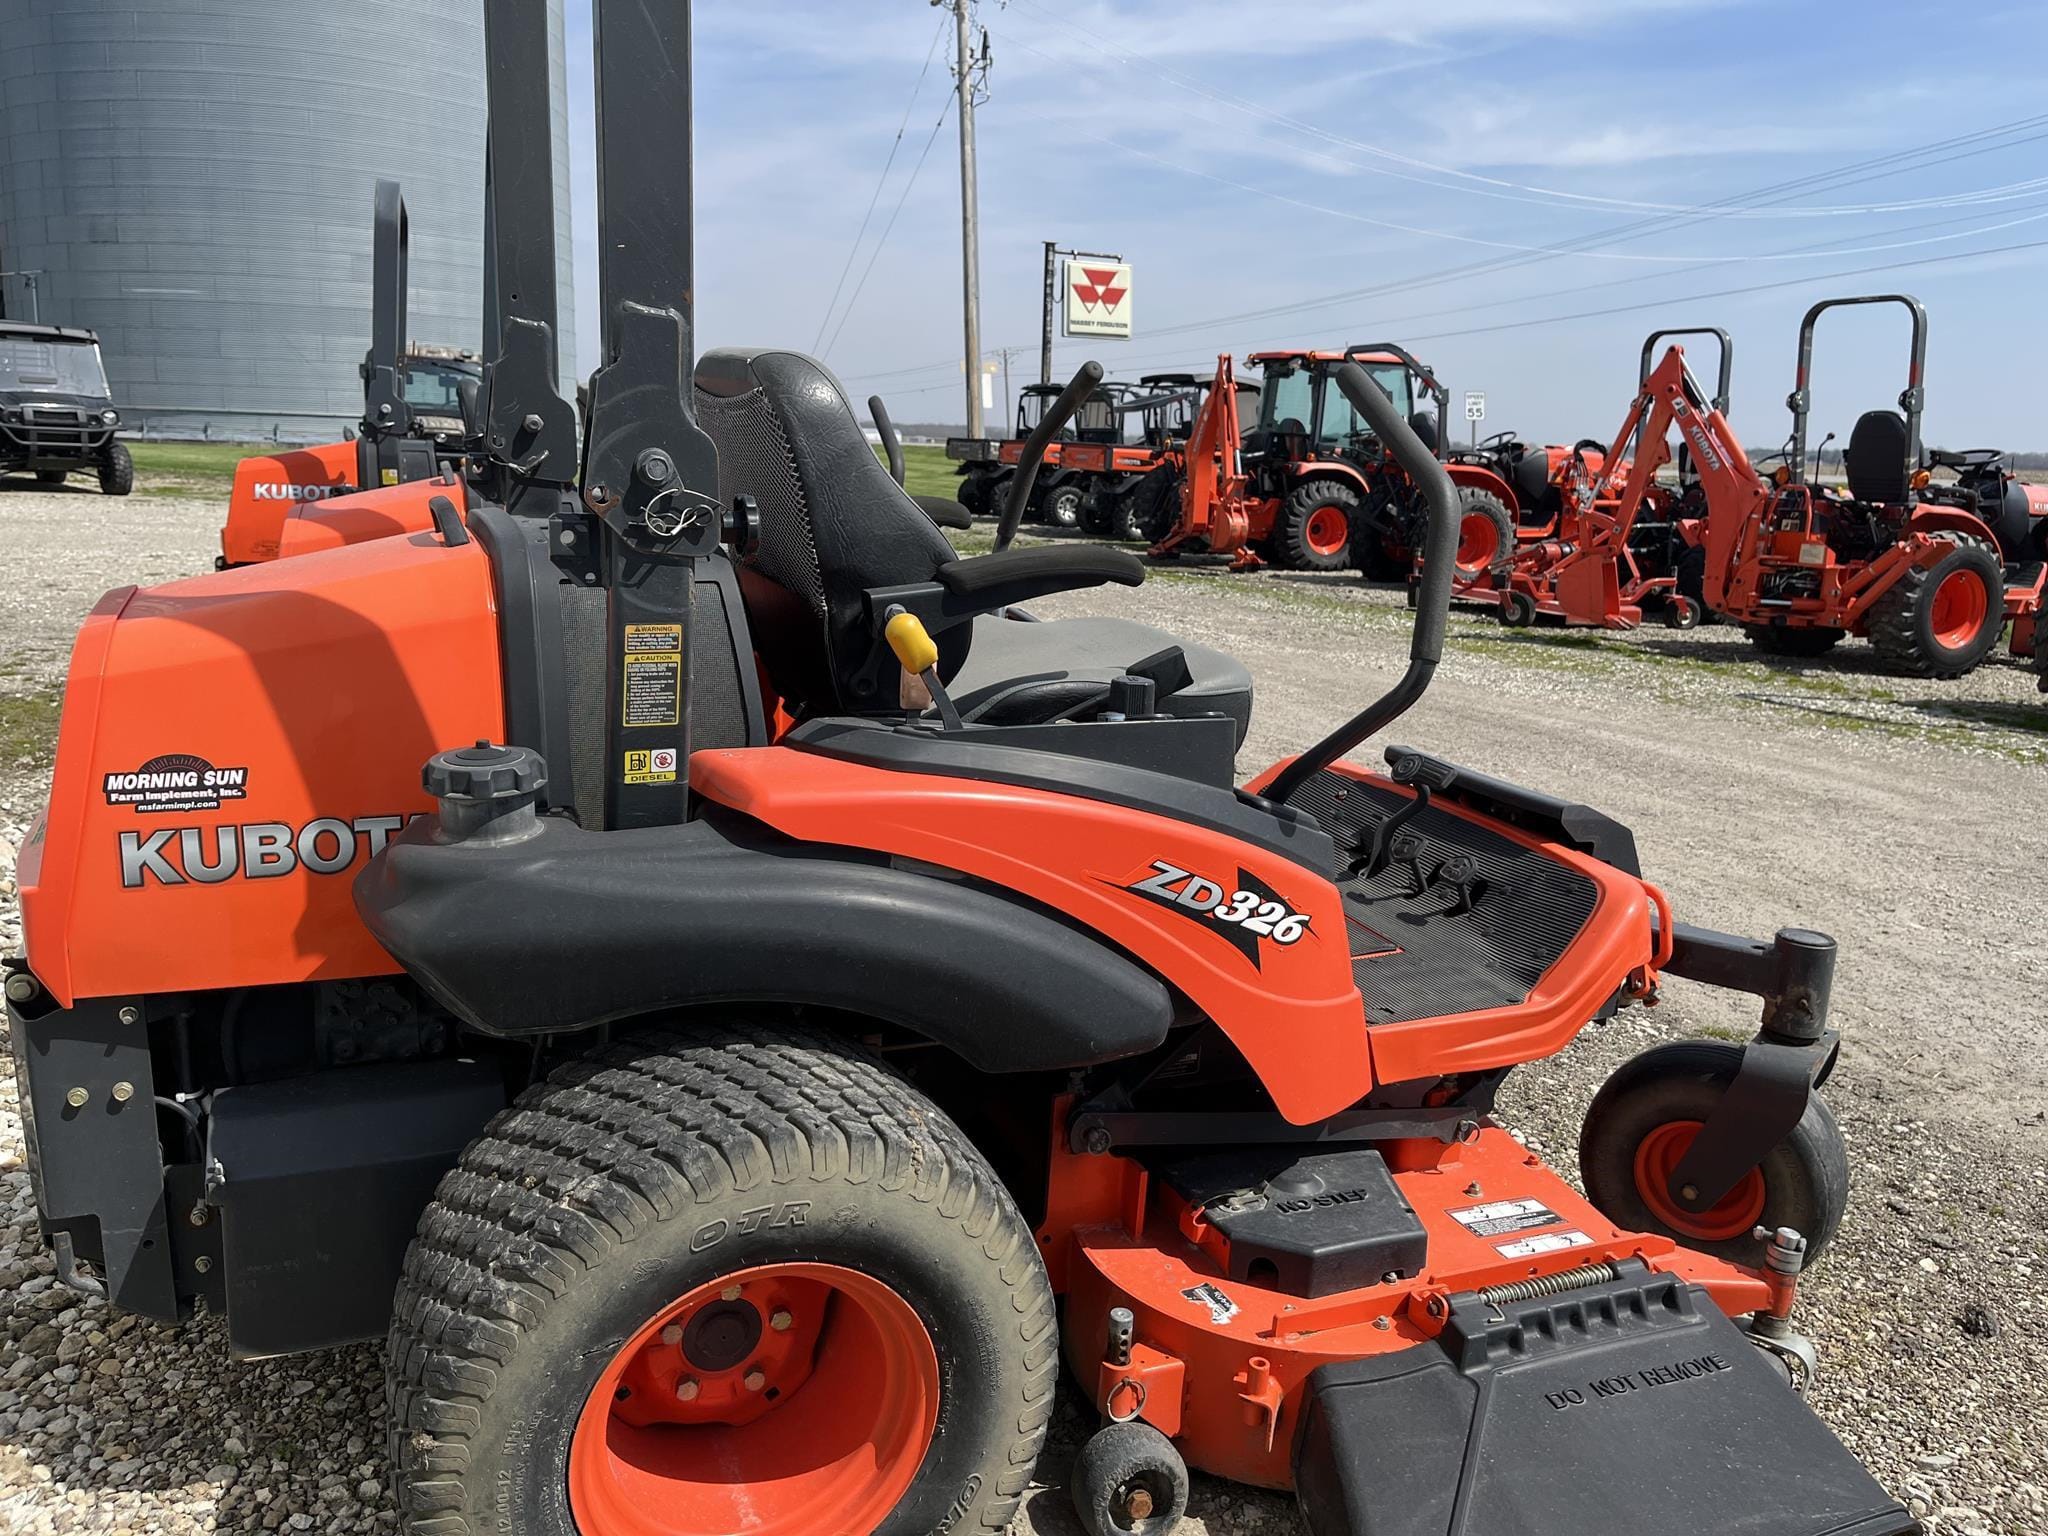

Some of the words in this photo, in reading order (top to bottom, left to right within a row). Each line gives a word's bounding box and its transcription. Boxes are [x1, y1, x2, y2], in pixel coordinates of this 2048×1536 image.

[1467, 408, 1483, 418] 55
[1689, 425, 1720, 470] KUBOTA
[254, 483, 353, 501] KUBOT
[2034, 502, 2048, 512] KU
[107, 771, 198, 790] MORNING
[203, 769, 244, 786] SUN
[631, 774, 670, 782] DIESEL
[110, 793, 144, 802] Farm
[145, 788, 218, 802] Implement,
[219, 787, 242, 797] Inc.
[137, 801, 218, 811] msfarmimpl.com
[118, 812, 428, 889] KUBOT
[1275, 1199, 1313, 1215] NO
[1313, 1188, 1369, 1208] STEP
[690, 1200, 813, 1254] OTR
[1544, 1387, 1586, 1411] DO
[1588, 1373, 1640, 1399] NOT
[1638, 1352, 1733, 1388] REMOVE
